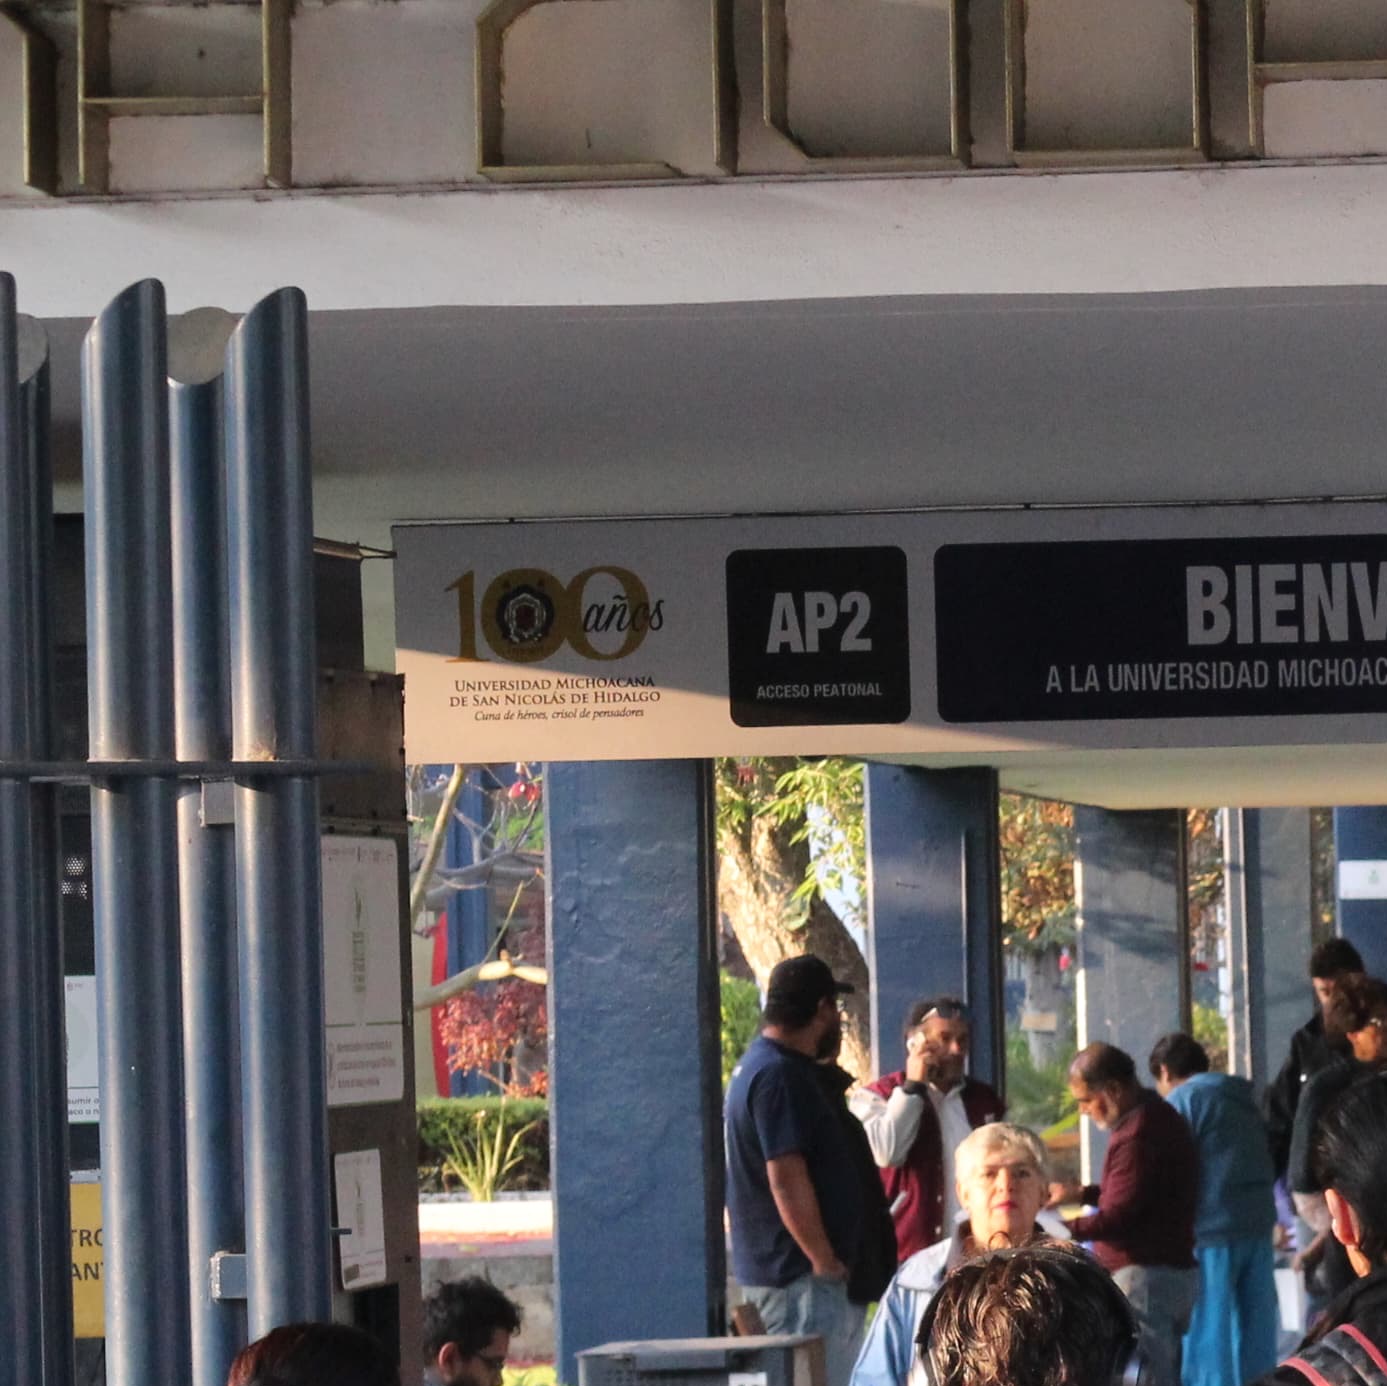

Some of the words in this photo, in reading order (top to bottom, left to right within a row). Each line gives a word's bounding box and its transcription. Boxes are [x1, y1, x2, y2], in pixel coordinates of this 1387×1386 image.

[444, 565, 651, 664] 100
[583, 595, 665, 634] años
[766, 591, 872, 654] AP2
[455, 679, 552, 693] UNIVERSIDAD
[556, 675, 655, 690] MICHOACANA
[1046, 665, 1063, 693] A
[1070, 664, 1101, 693] LA
[1108, 660, 1269, 692] UNIVERSIDAD
[450, 695, 468, 708] DE
[472, 693, 500, 707] SAN
[504, 690, 566, 706] NICOLÁS
[570, 692, 590, 704] DE
[593, 690, 661, 704] HIDALGO
[757, 684, 810, 699] ACCESO
[813, 682, 883, 698] PEATONAL
[474, 710, 501, 721] Cuna
[503, 709, 516, 721] de
[579, 707, 592, 719] de
[591, 706, 645, 721] pensadores
[70, 1261, 104, 1281] AN
